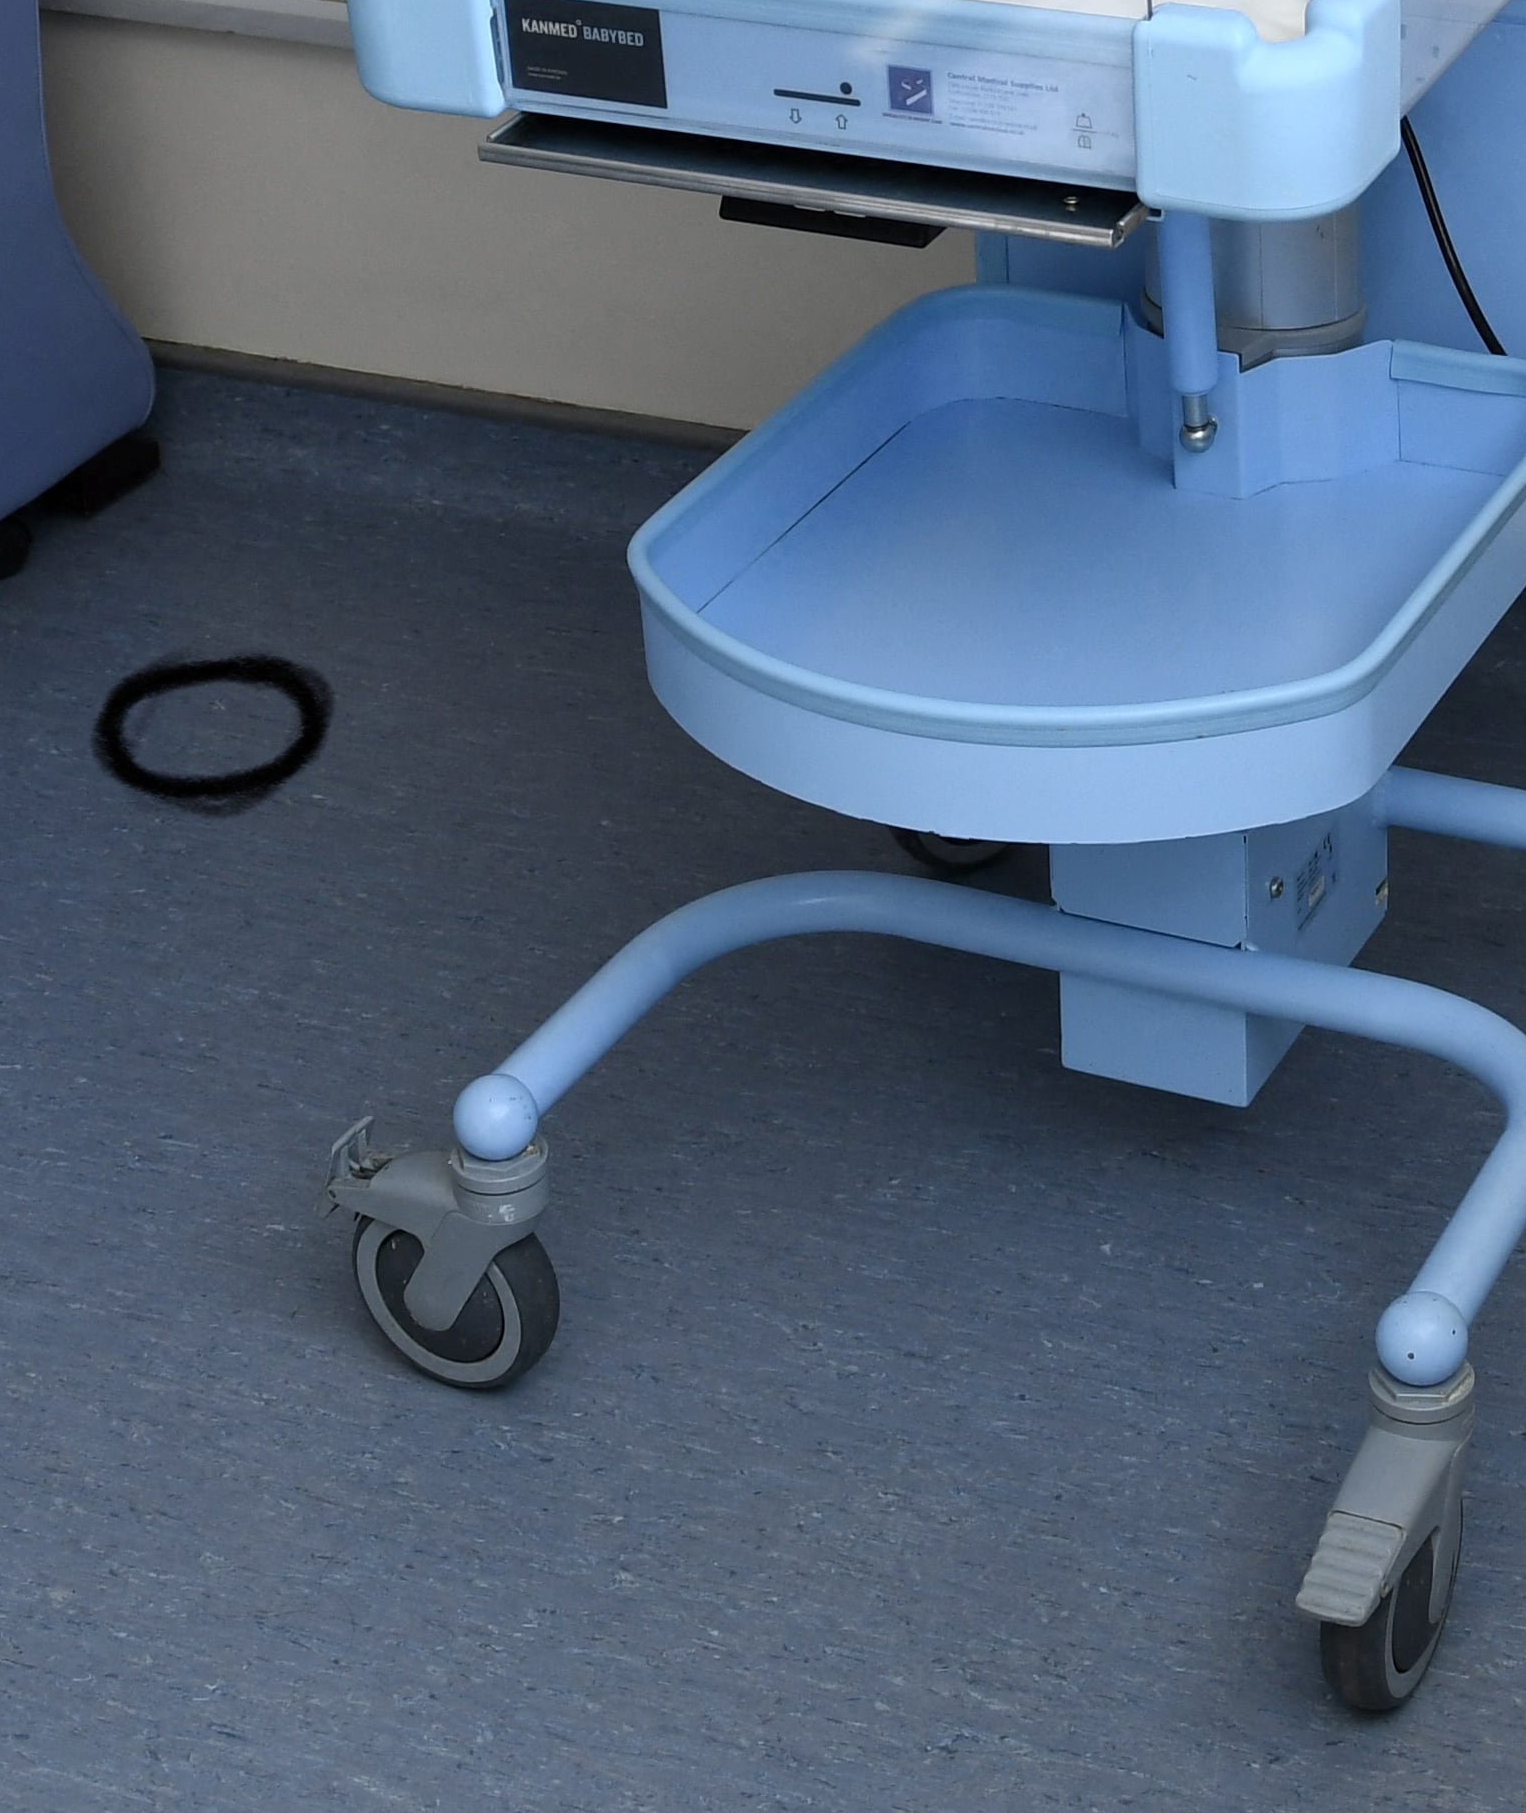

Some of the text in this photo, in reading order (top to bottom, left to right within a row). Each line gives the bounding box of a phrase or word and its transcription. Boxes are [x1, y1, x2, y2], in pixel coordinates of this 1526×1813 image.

[522, 18, 644, 47] KANMED BABYBED
[948, 72, 1059, 92] Central Medical Supplies Ltd
